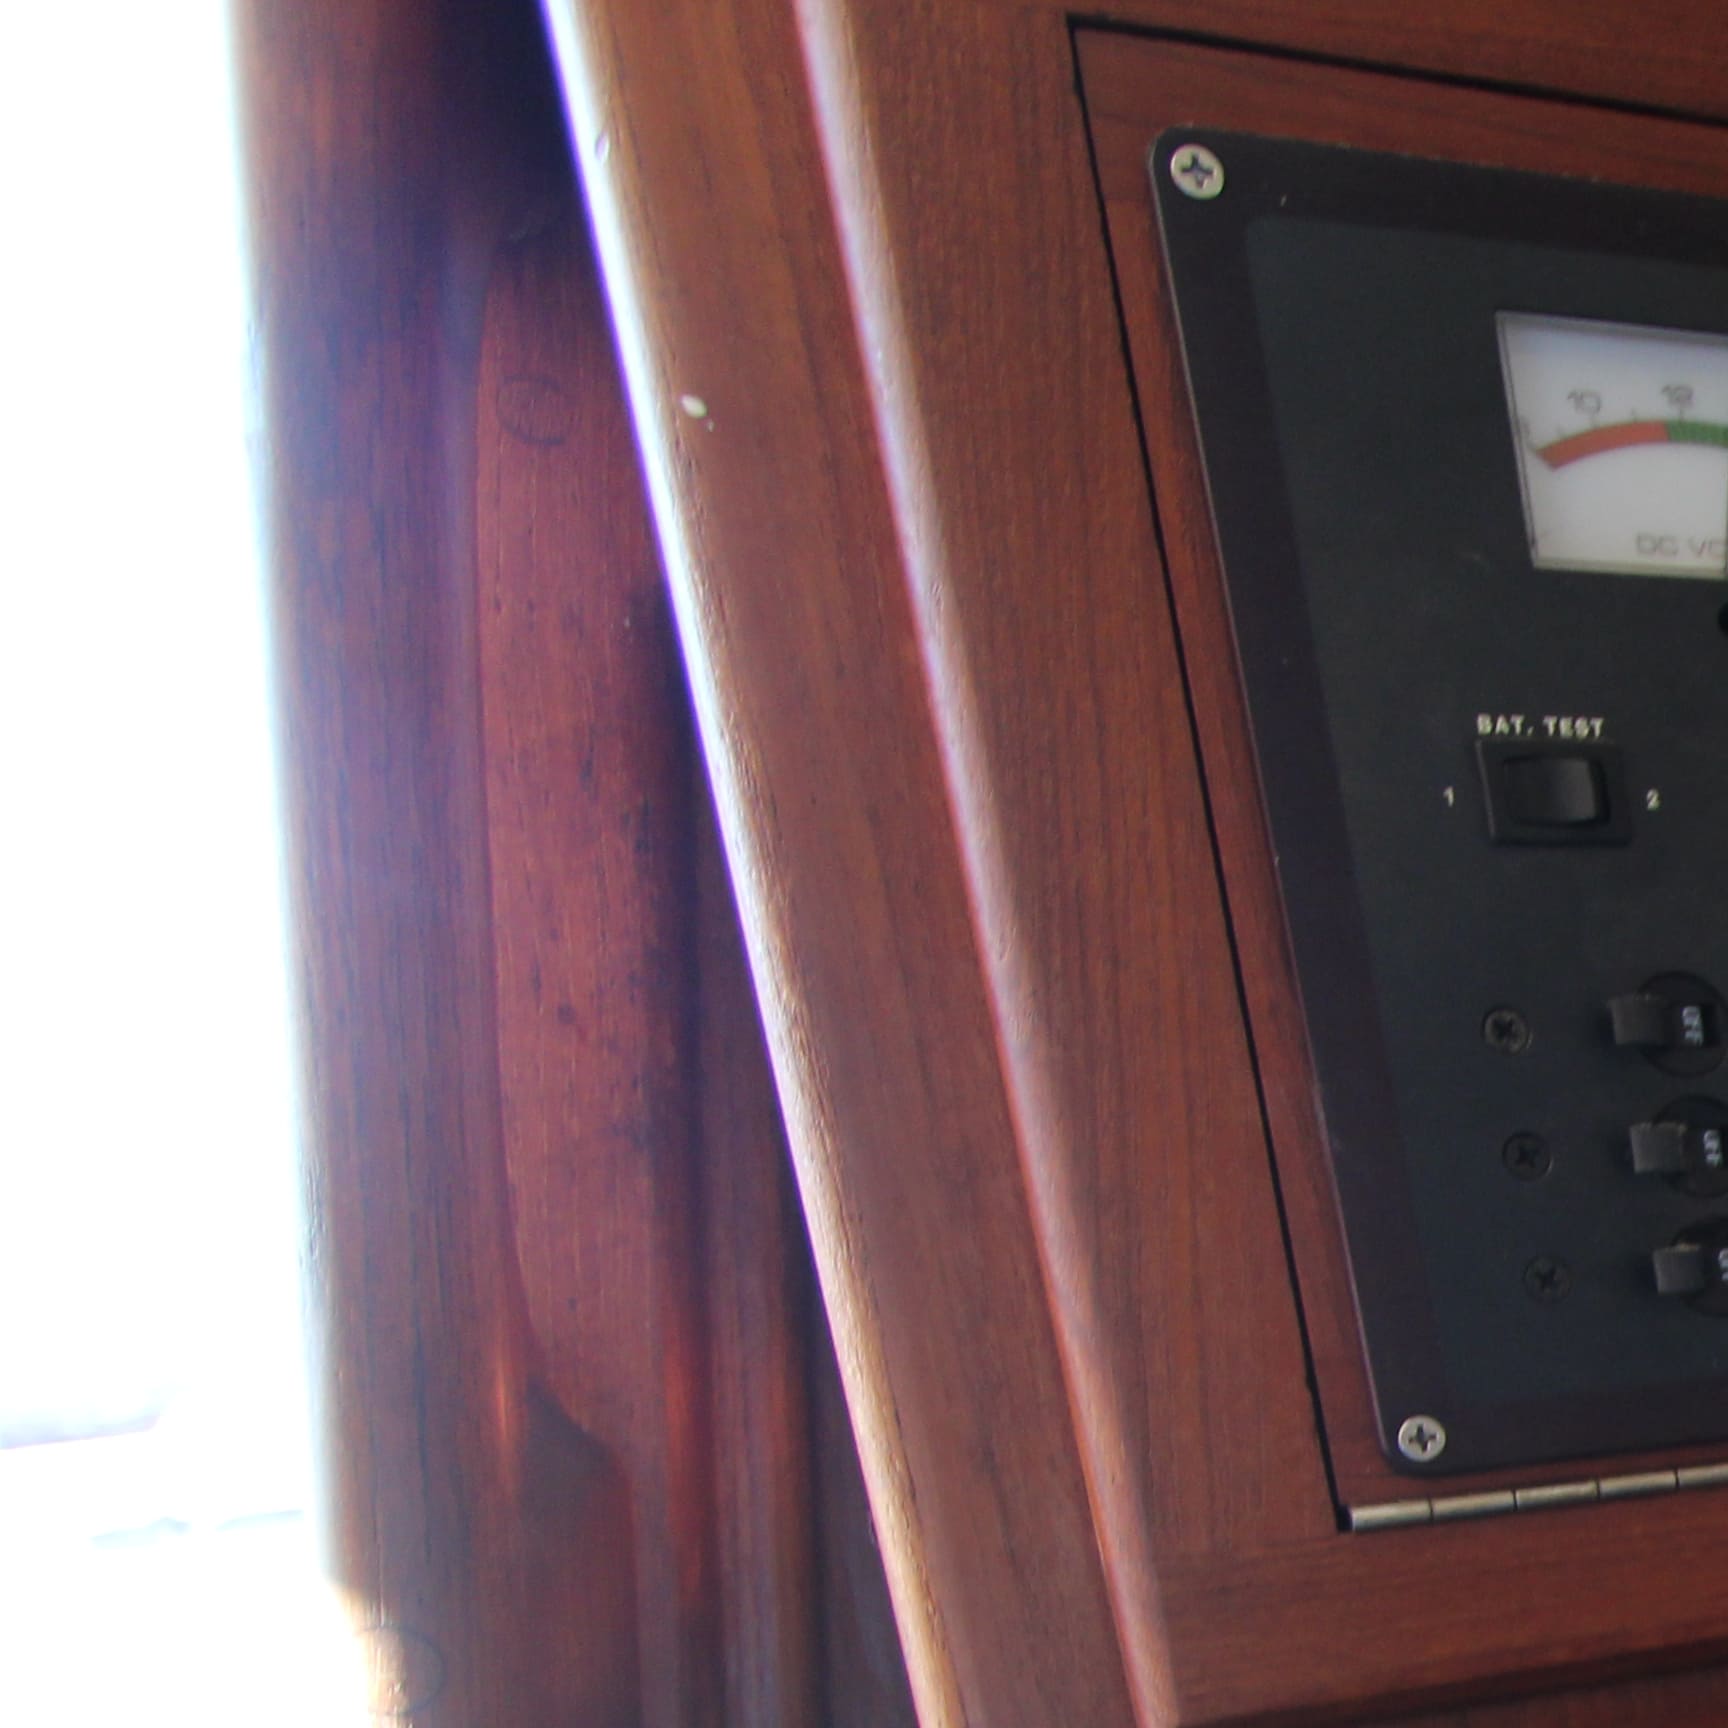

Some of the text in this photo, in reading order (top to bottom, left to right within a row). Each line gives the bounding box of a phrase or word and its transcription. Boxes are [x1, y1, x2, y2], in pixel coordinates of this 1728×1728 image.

[1636, 533, 1679, 557] DC
[1543, 715, 1604, 738] TEST
[1443, 786, 1455, 807] 1
[1646, 789, 1661, 811] 2
